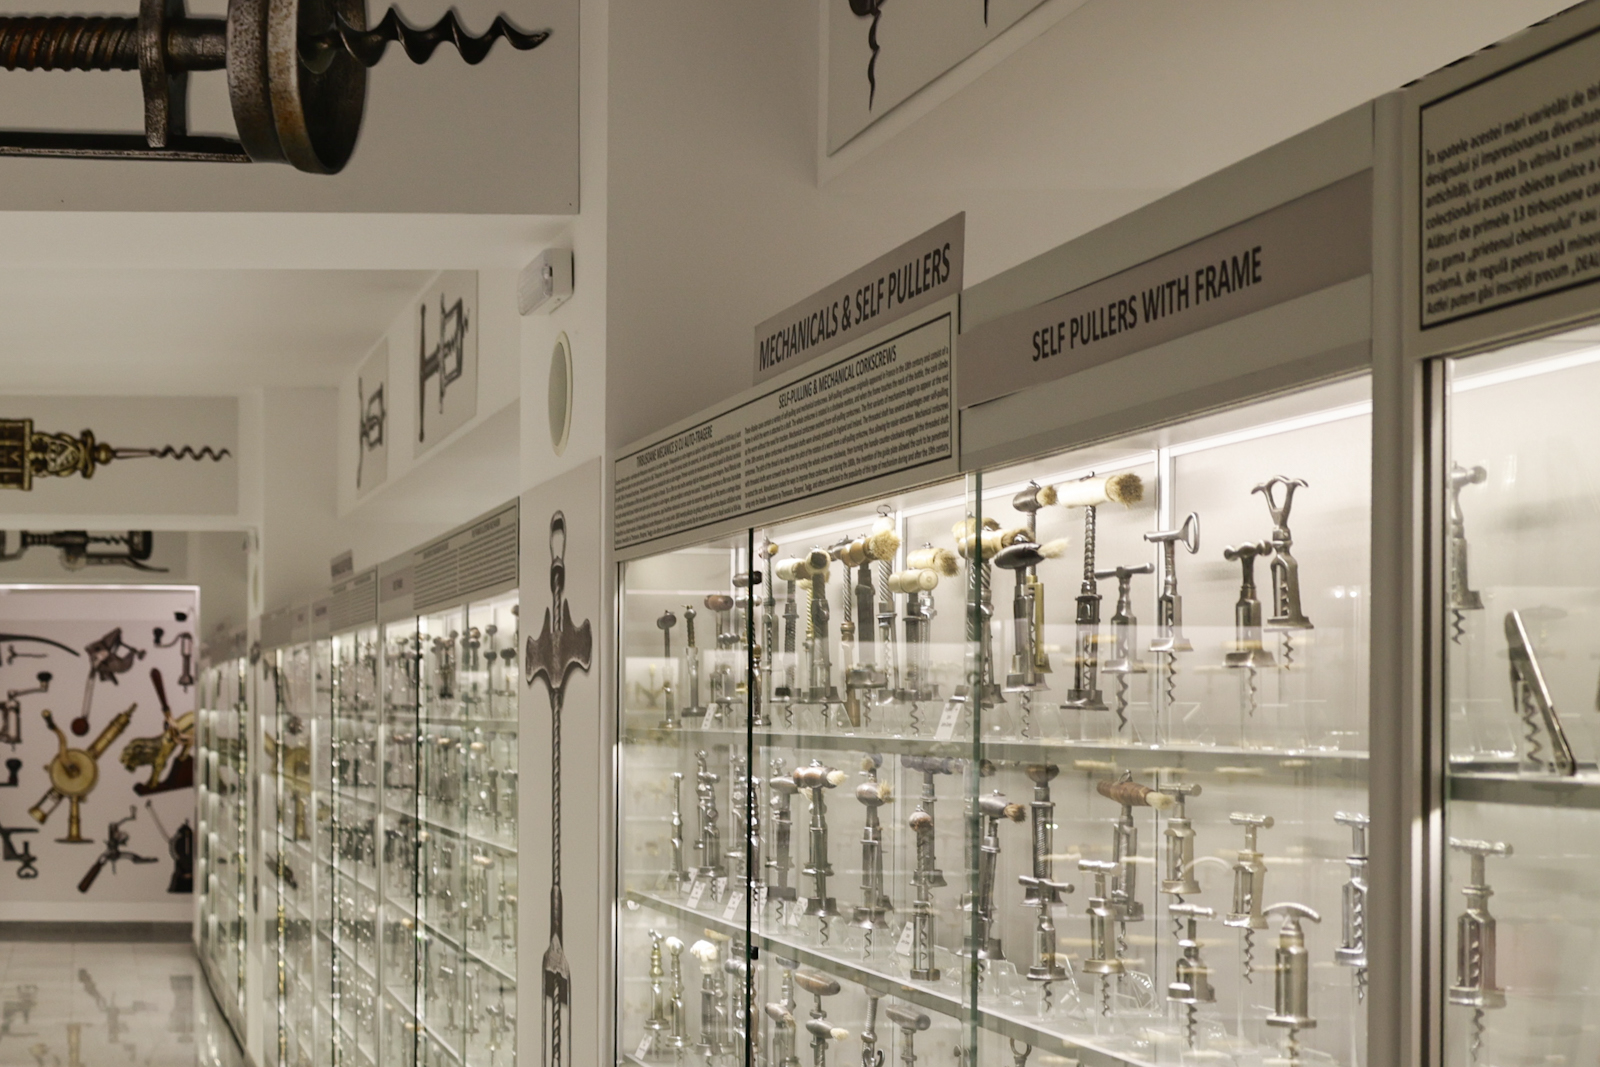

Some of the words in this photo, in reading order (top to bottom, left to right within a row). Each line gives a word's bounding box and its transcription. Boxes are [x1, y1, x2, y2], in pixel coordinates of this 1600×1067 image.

[1514, 205, 1524, 222] 13
[759, 301, 838, 371] MECHANICALS
[841, 294, 852, 331] &
[855, 277, 885, 325] SELF
[888, 243, 950, 309] PULLERS
[1032, 321, 1065, 362] SELF
[1070, 295, 1138, 350] PULLERS
[1142, 275, 1190, 324] WITH
[1195, 246, 1263, 305] FRAME
[779, 382, 812, 409] SELF-PULLING
[819, 364, 855, 392] MECHANICAL
[856, 345, 897, 377] CORKSCREWS
